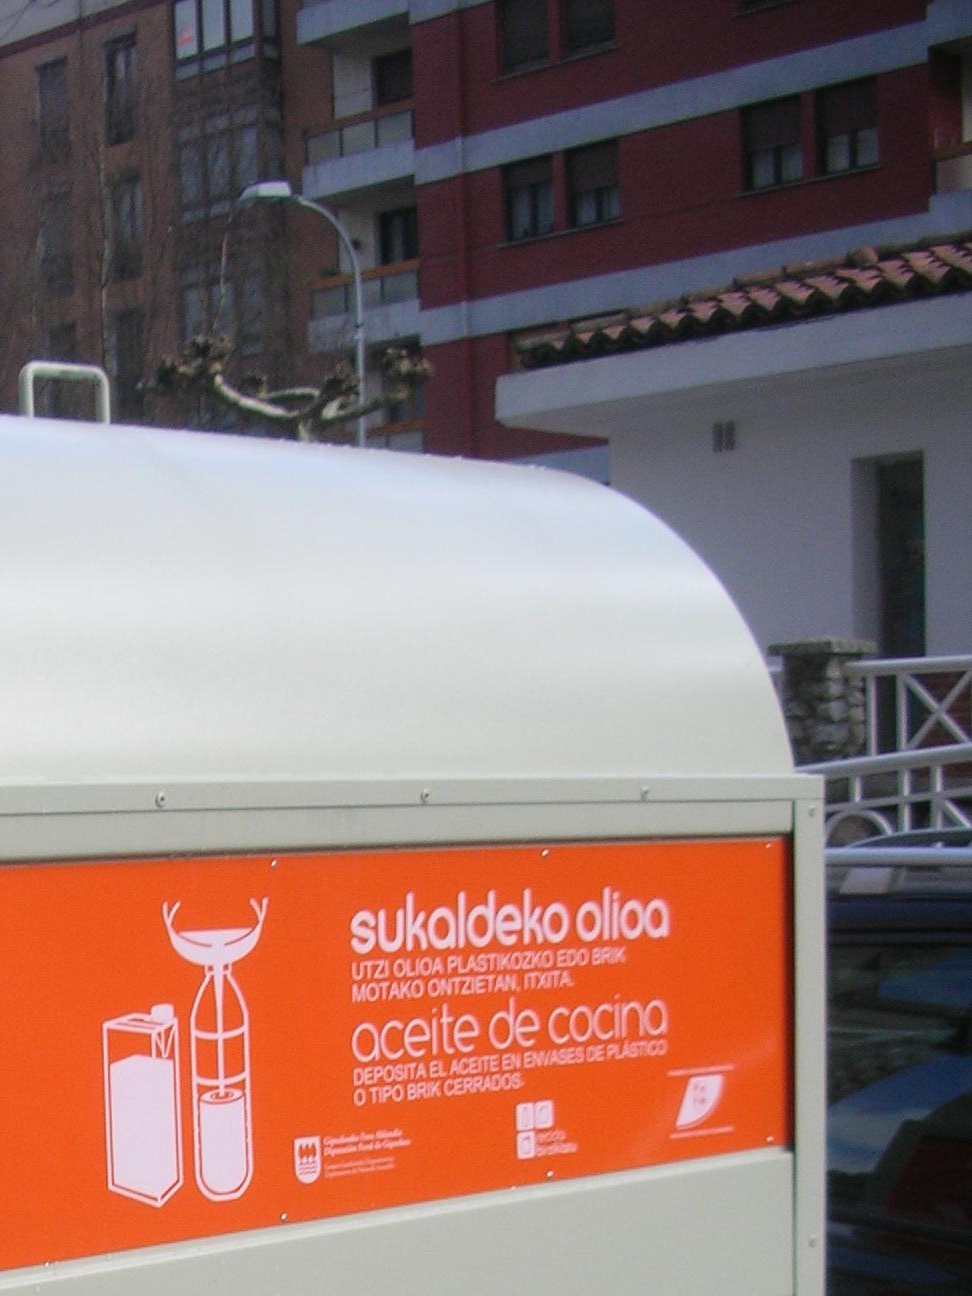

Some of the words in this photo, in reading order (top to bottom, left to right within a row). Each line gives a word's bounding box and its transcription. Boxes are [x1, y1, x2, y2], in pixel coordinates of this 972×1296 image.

[350, 888, 570, 955] sukaldeko
[575, 886, 671, 942] olioa
[351, 959, 390, 981] UTZI
[393, 956, 445, 979] OLIOA
[447, 949, 554, 975] PLASTIKOZKO
[556, 949, 590, 968] EDO
[591, 946, 627, 966] BRIK
[351, 980, 424, 1003] MOTAKO
[427, 971, 520, 998] ONTZIETAN,
[351, 1002, 481, 1063] aceite
[488, 996, 541, 1050] de
[547, 993, 669, 1045] cocina
[353, 1061, 428, 1087] DEPOSITA
[429, 1060, 447, 1078] EL
[449, 1053, 500, 1076] ACEITE
[501, 1052, 522, 1070] EN
[523, 1045, 586, 1068] ENVASES
[586, 1044, 606, 1063] DE
[353, 1088, 367, 1107] O
[369, 1083, 405, 1104] TIPO
[406, 1080, 442, 1101] BRIK
